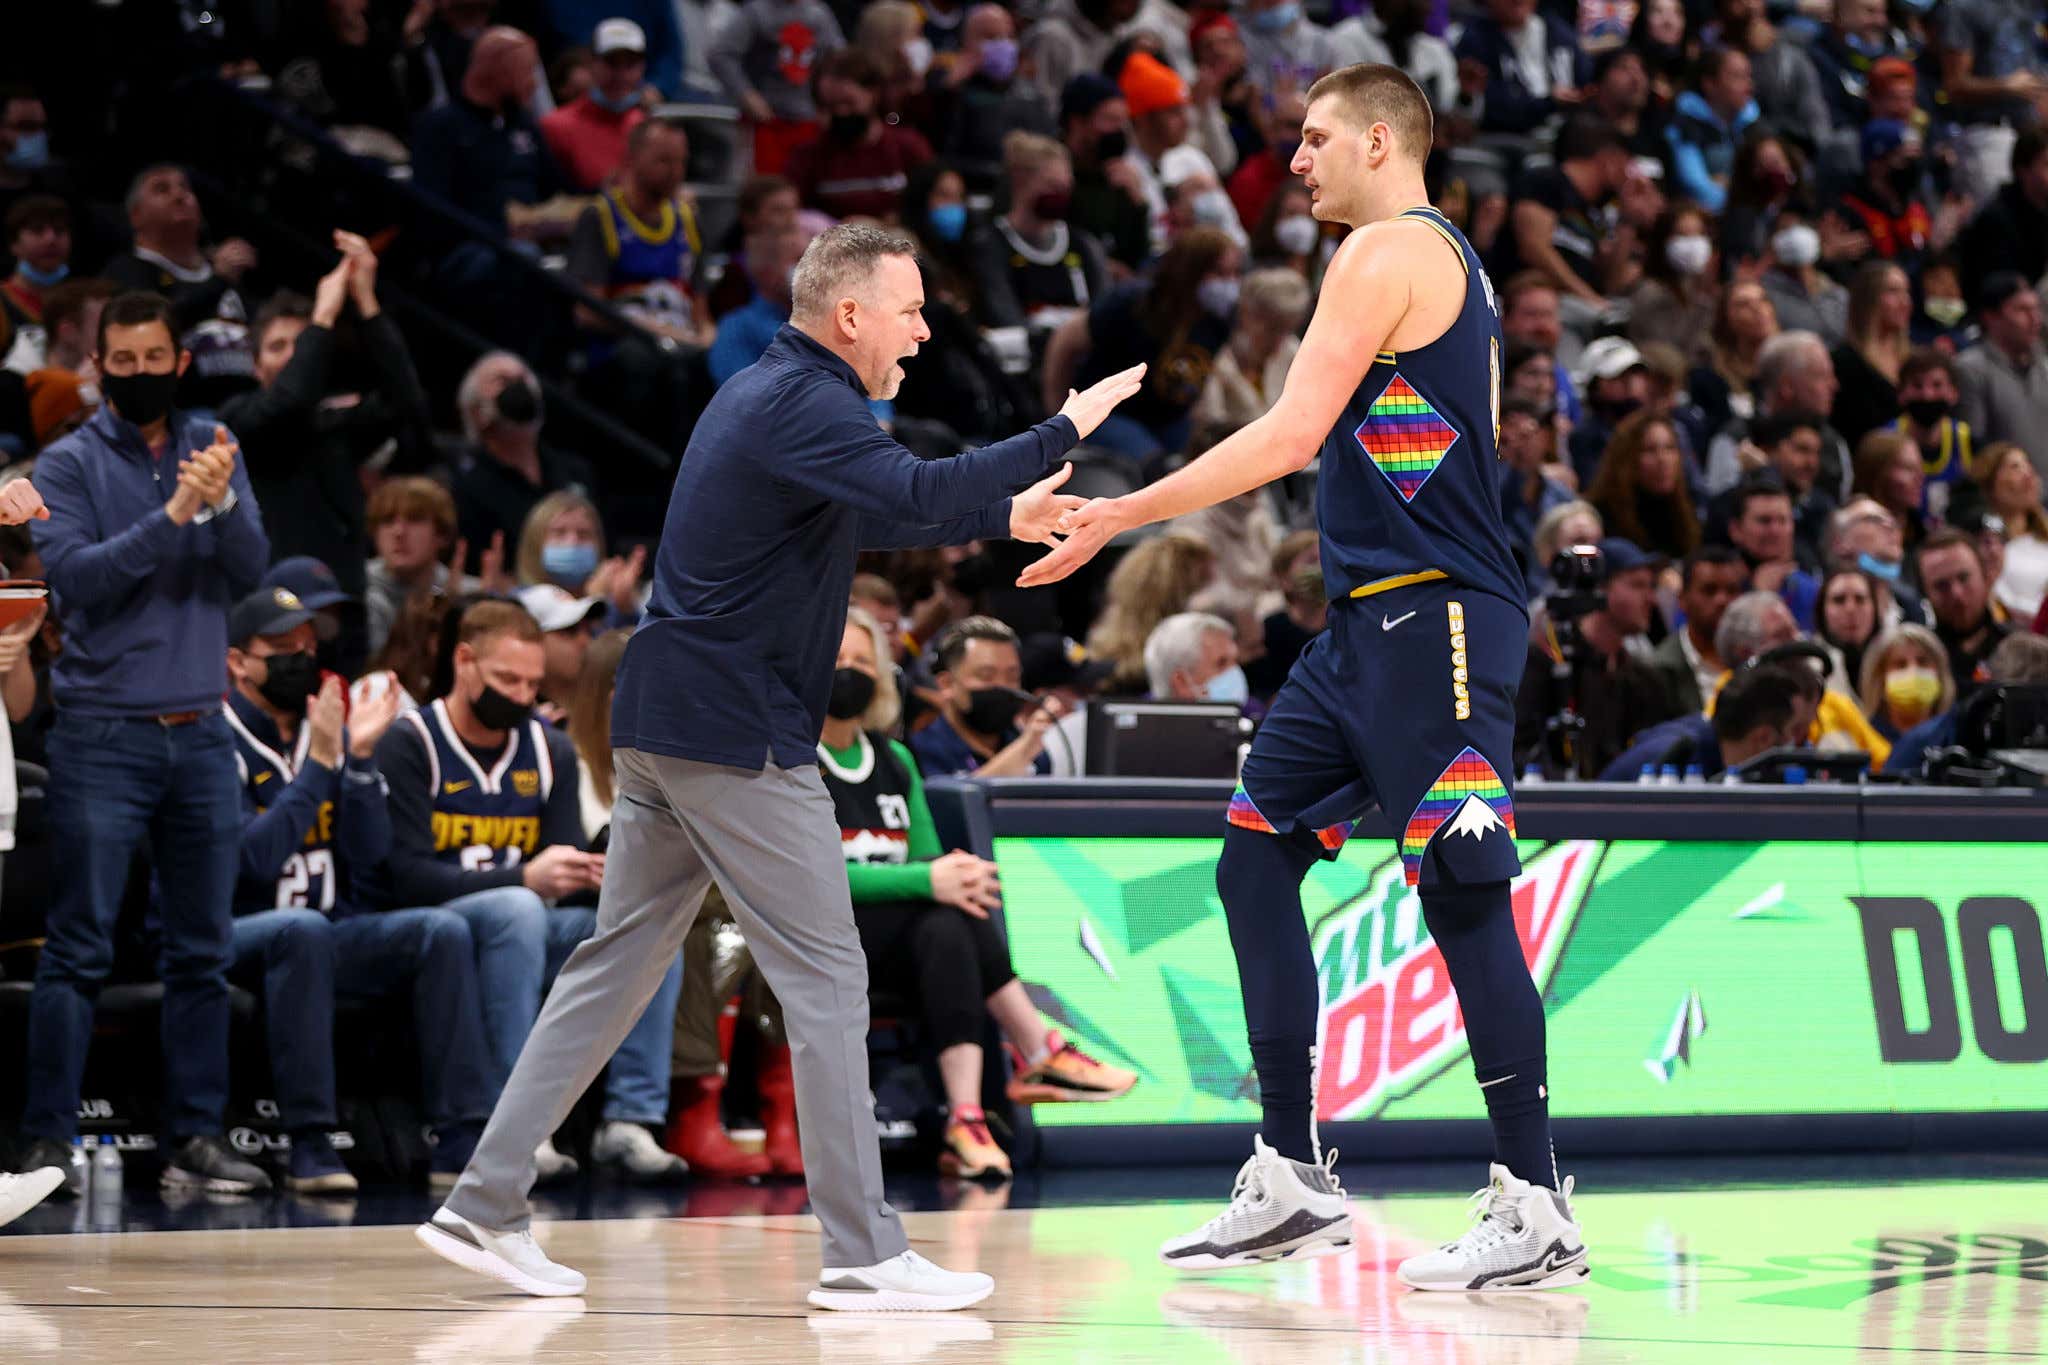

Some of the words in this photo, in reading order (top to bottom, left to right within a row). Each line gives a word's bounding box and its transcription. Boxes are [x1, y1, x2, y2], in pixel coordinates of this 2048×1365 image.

[275, 848, 336, 912] 27
[1317, 876, 1430, 1007] Mt
[1844, 896, 2048, 1062] DO
